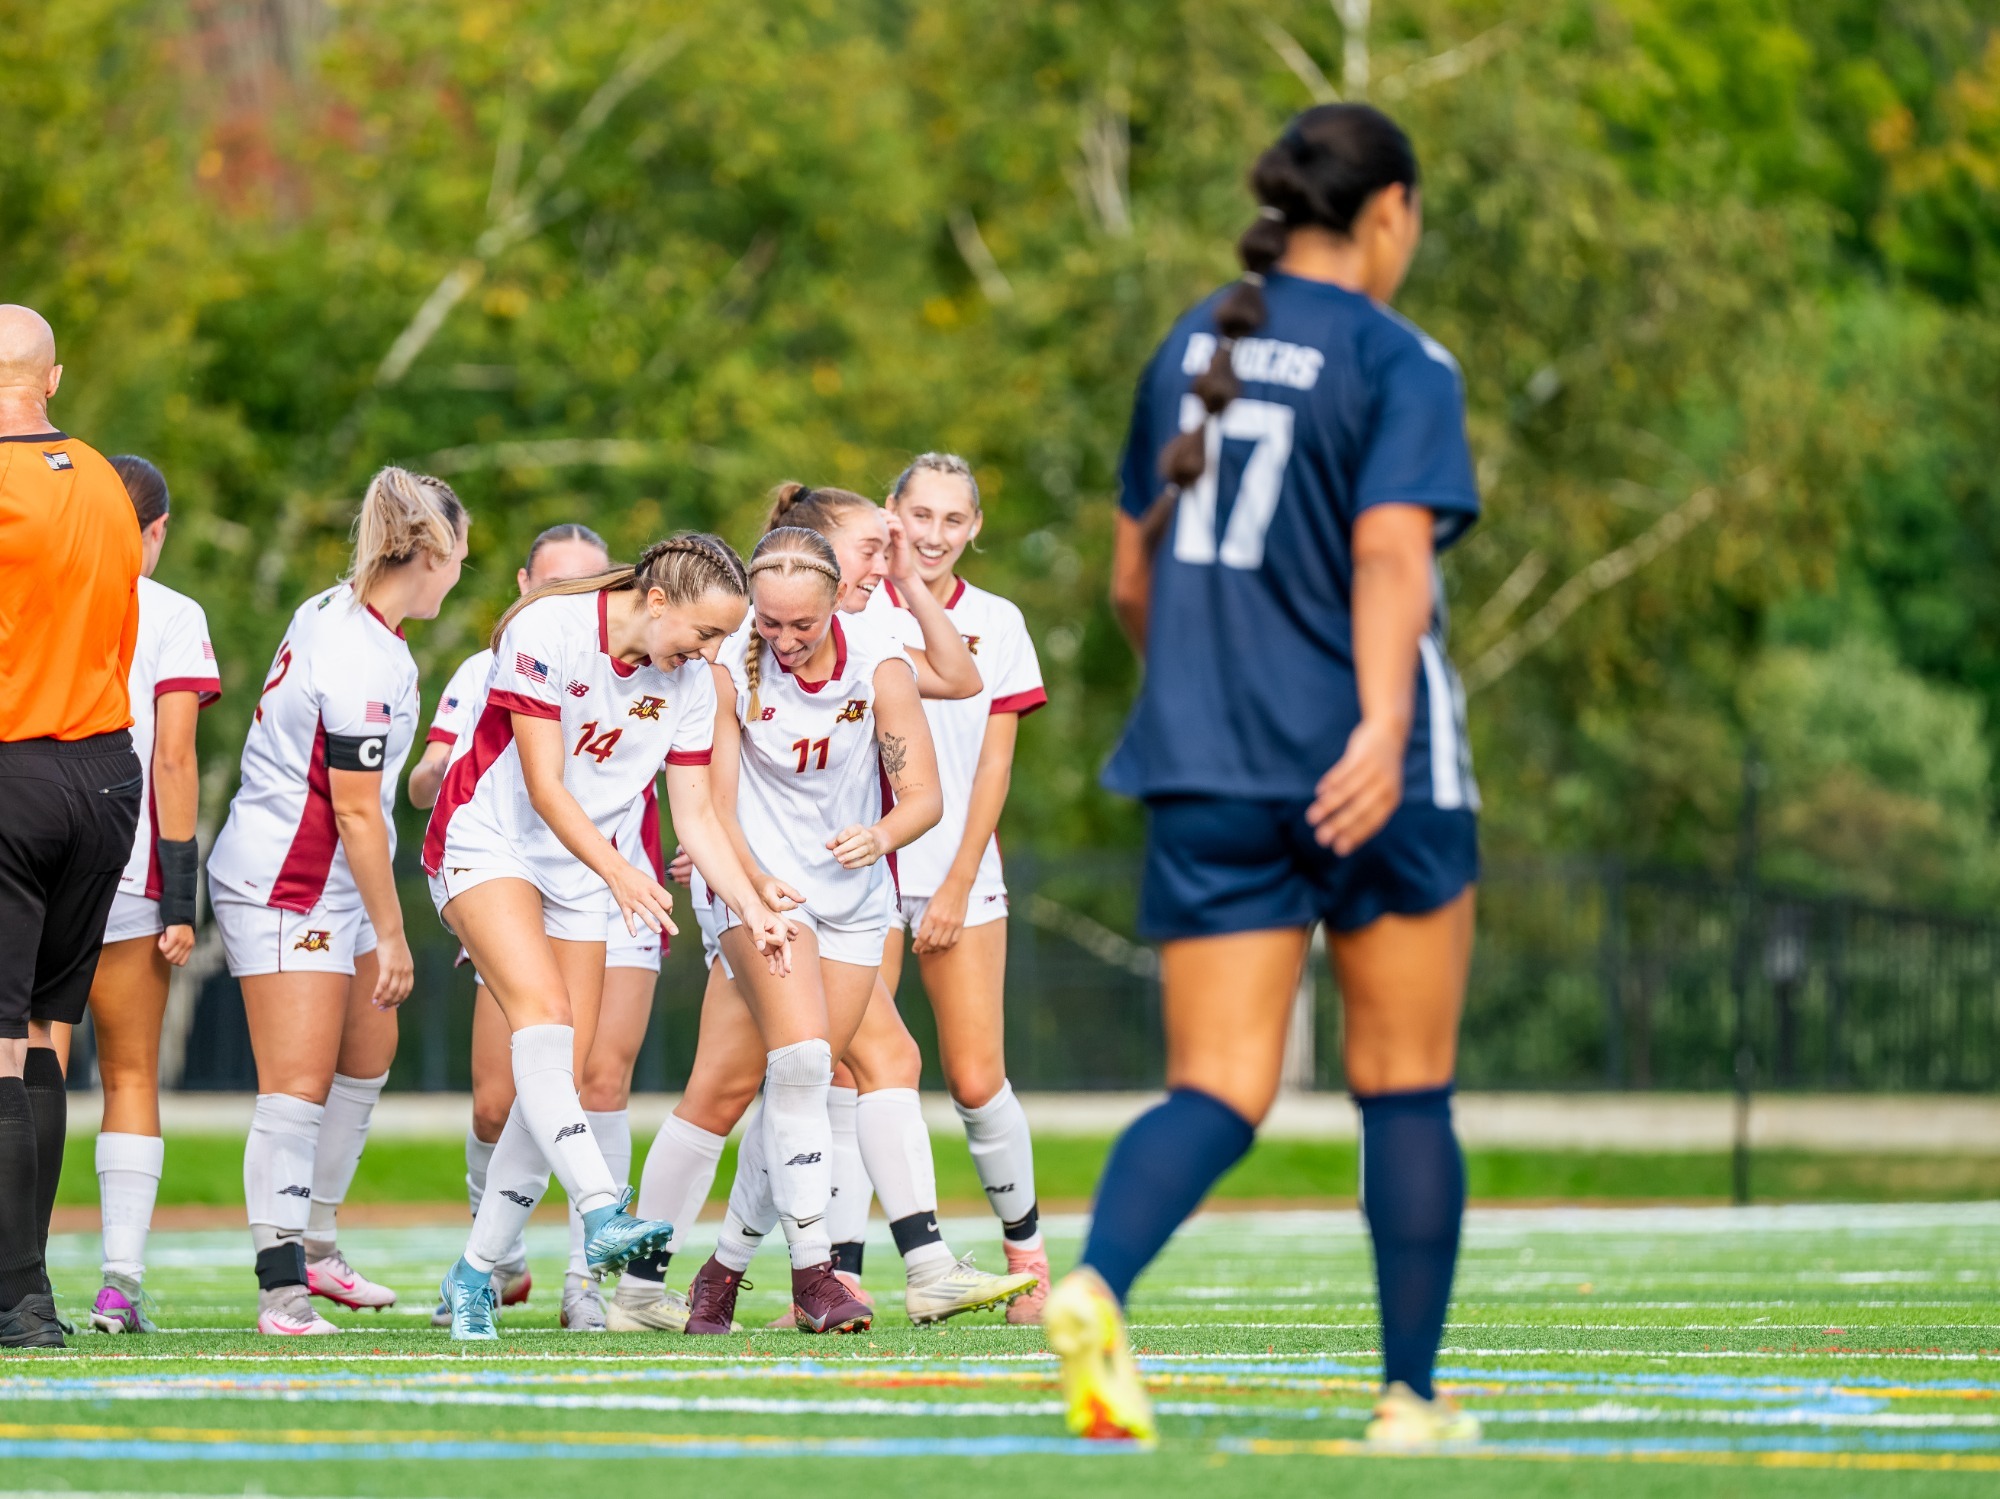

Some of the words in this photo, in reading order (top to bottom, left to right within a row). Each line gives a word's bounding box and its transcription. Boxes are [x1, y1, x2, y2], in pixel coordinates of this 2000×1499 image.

[1181, 332, 1325, 390] RDERS
[1174, 394, 1295, 569] 17
[358, 737, 383, 767] C
[573, 720, 623, 763] 14
[792, 736, 830, 773] 11
